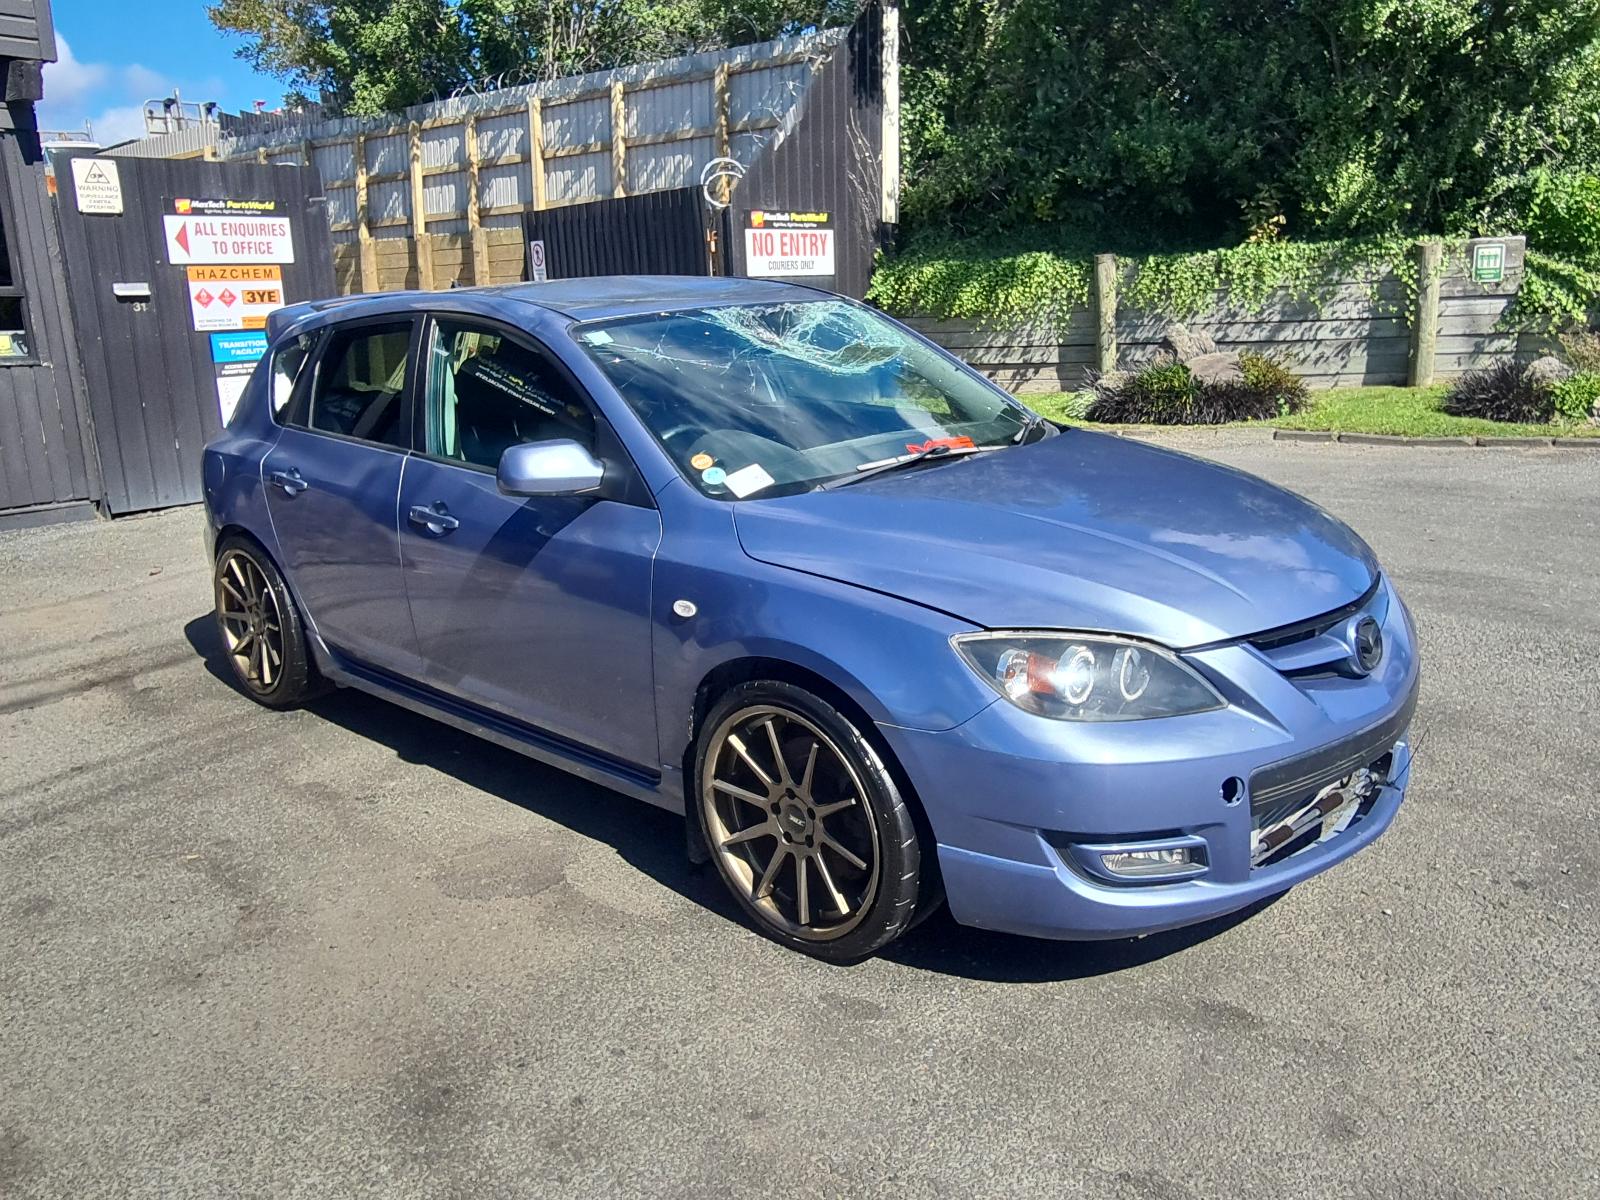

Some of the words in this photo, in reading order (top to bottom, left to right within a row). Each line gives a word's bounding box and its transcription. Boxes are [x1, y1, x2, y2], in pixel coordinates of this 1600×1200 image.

[226, 200, 275, 210] PartsWorld
[194, 222, 218, 236] ALL
[221, 222, 286, 237] ENQUIRIES
[212, 241, 228, 254] TO
[232, 241, 274, 254] OFFICE
[752, 232, 774, 256] NO
[780, 232, 828, 256] ENTRY
[768, 260, 798, 271] COURIERS
[800, 260, 815, 270] ONLY
[196, 268, 273, 279] HAZCHEM
[246, 291, 277, 303] 3YE
[133, 302, 146, 311] 31
[218, 340, 268, 349] TRANSITION
